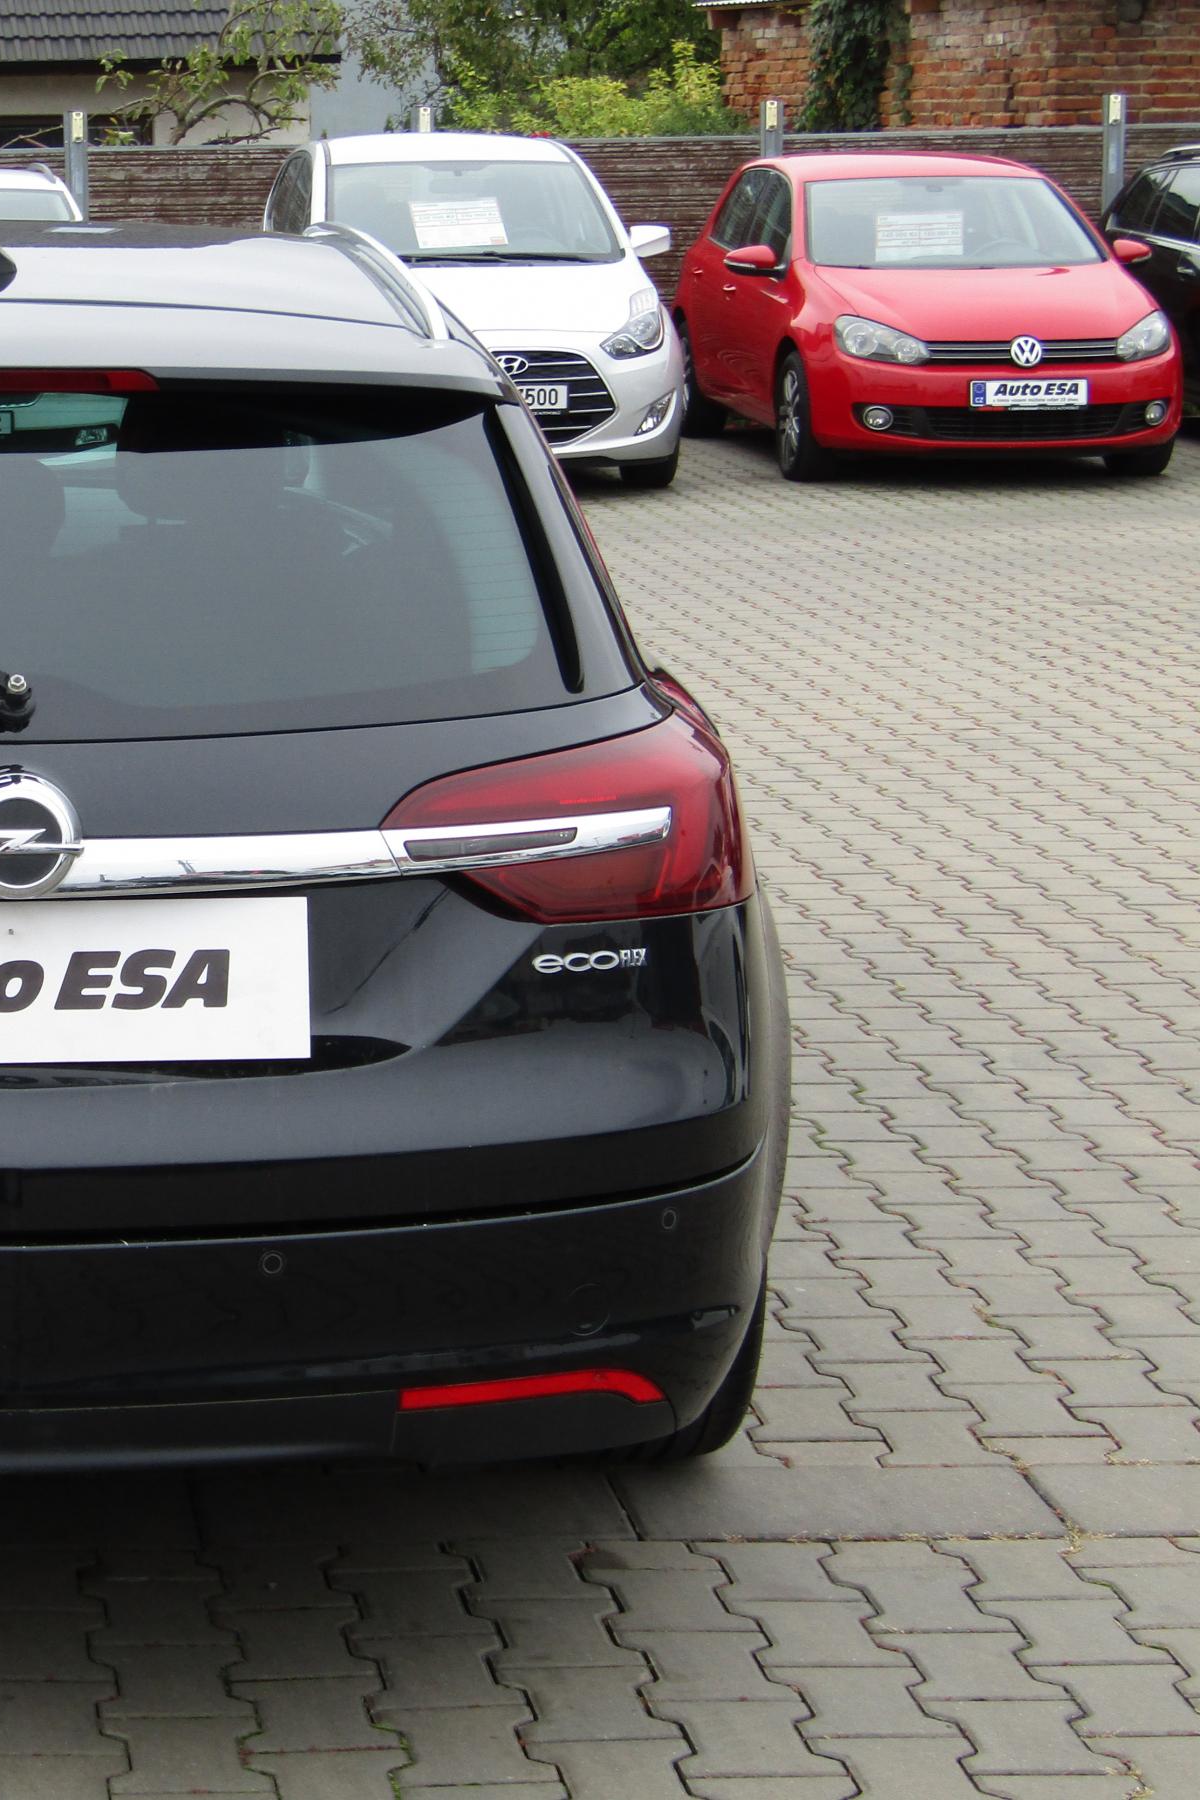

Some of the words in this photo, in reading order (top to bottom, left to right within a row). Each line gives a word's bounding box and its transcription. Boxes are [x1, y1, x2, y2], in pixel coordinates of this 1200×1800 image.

[519, 388, 558, 406] 500
[994, 384, 1041, 396] Auto
[1044, 383, 1079, 395] ESA
[54, 949, 230, 1010] ESA
